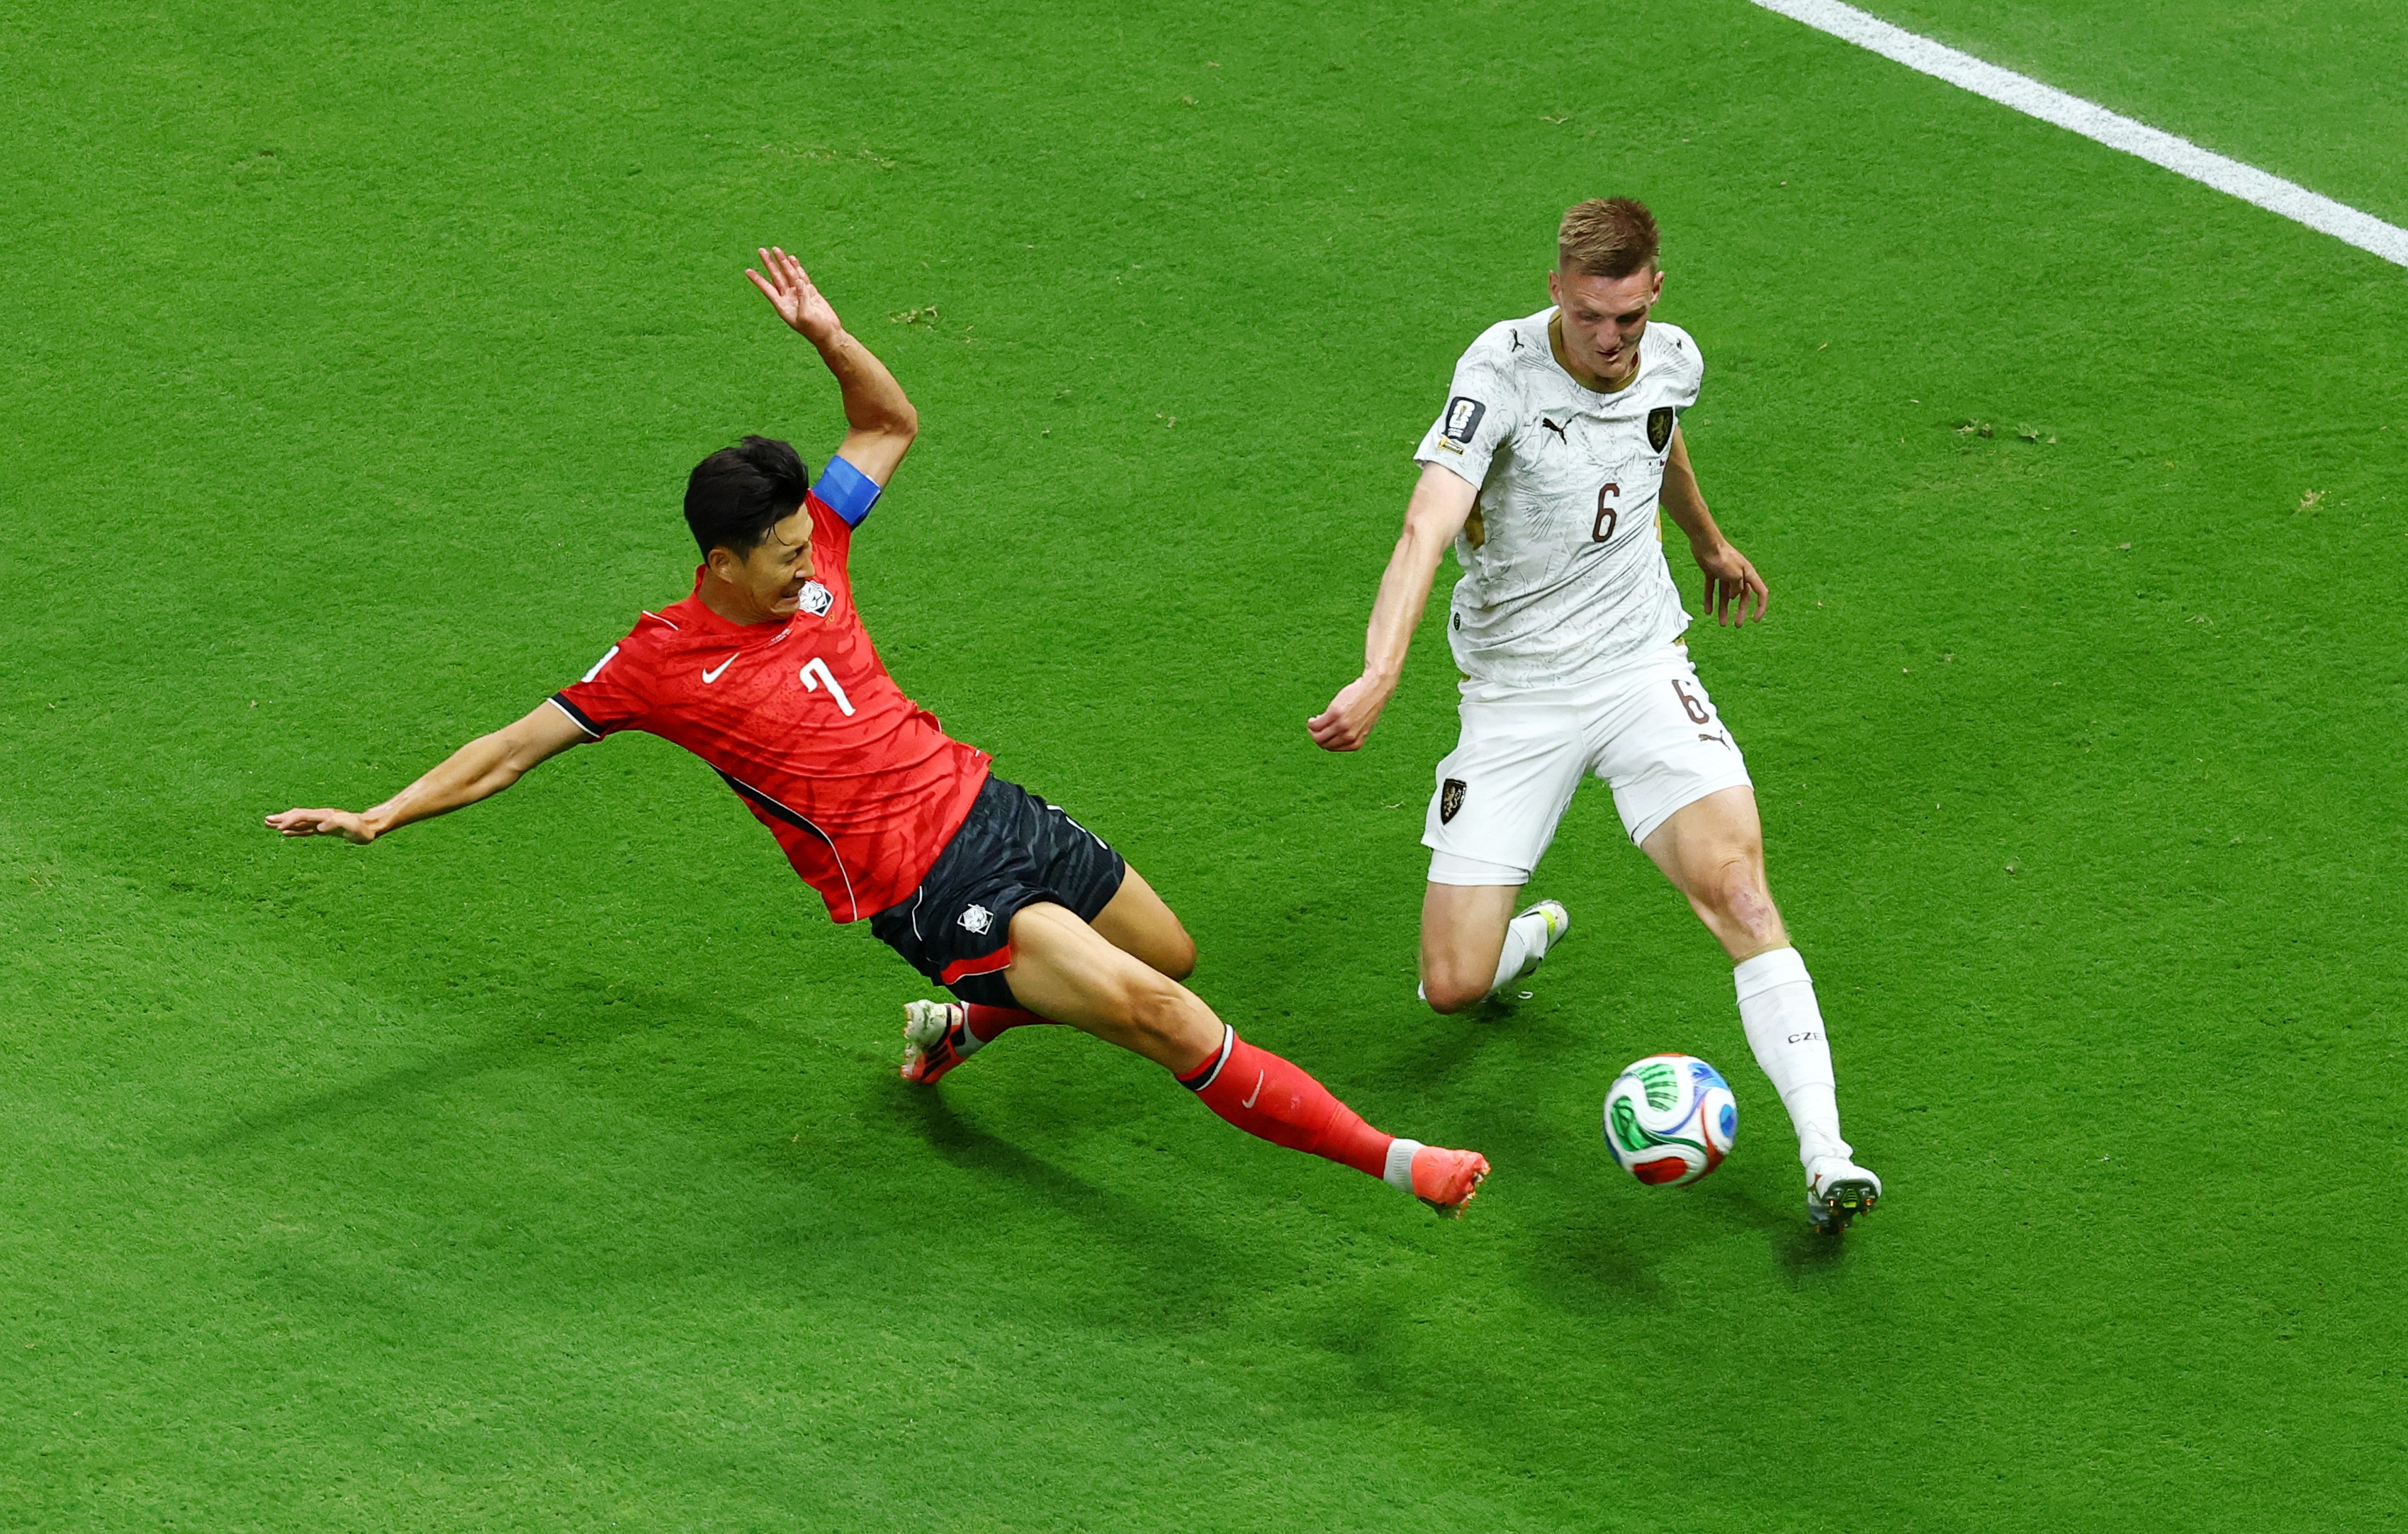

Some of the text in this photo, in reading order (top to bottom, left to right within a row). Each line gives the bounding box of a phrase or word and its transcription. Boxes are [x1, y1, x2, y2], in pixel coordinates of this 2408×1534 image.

[1592, 483, 1620, 543] 6
[799, 656, 857, 717] 7
[1671, 679, 1709, 724] 6
[1788, 1031, 1823, 1044] CZE
